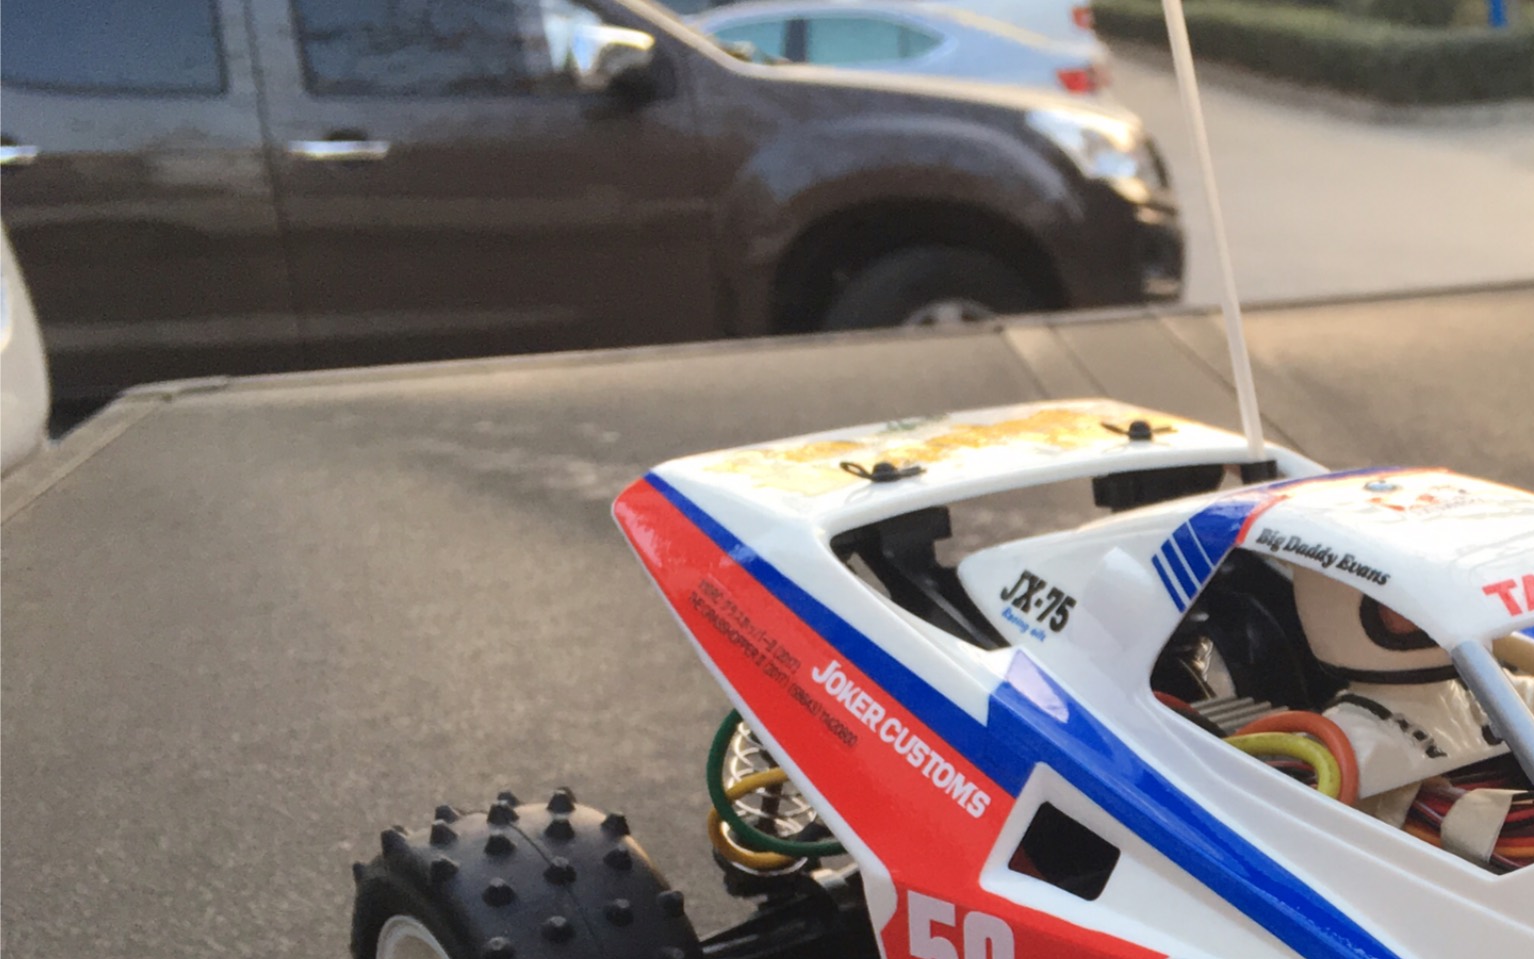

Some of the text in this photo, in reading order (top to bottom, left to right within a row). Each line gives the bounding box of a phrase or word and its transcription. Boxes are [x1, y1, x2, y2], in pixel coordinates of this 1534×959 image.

[1256, 527, 1391, 586] Big Daddy Evans
[1000, 569, 1077, 633] JX-75
[811, 659, 992, 819] JOKER CUSTOMS
